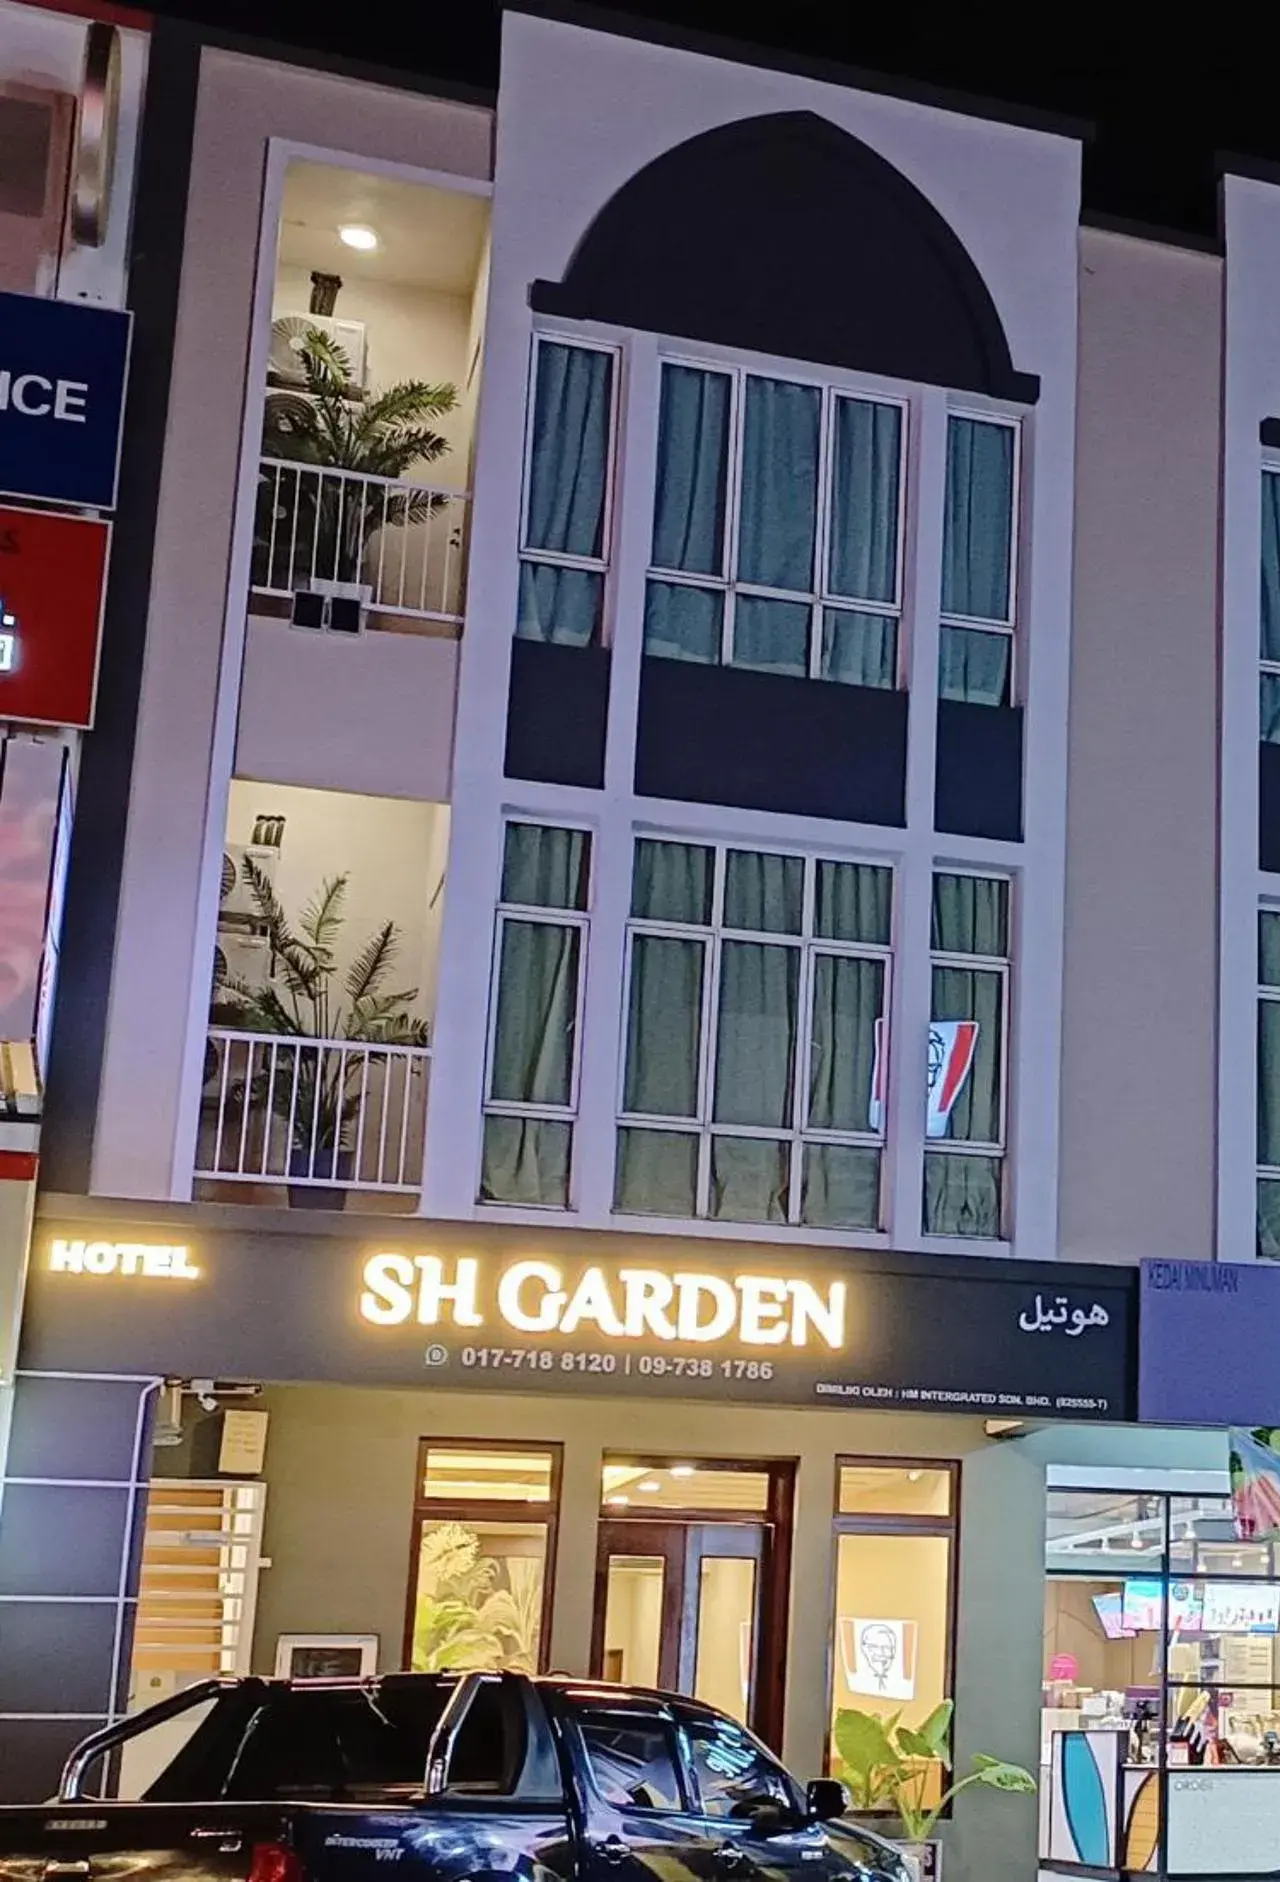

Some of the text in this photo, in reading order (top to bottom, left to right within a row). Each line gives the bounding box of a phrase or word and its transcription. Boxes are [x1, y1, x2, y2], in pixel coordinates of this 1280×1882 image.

[50, 1239, 200, 1280] HOTEL
[1149, 1261, 1182, 1291] KEDAI
[360, 1253, 847, 1349] SH GARDEN
[1018, 1293, 1110, 1336] هوتيل
[461, 1347, 553, 1370] 017-718
[560, 1352, 617, 1373] 8120
[638, 1356, 713, 1378] 09-738
[720, 1360, 774, 1380] 1786
[920, 1390, 996, 1404] INTERGRATED
[375, 1847, 406, 1861] VNT
